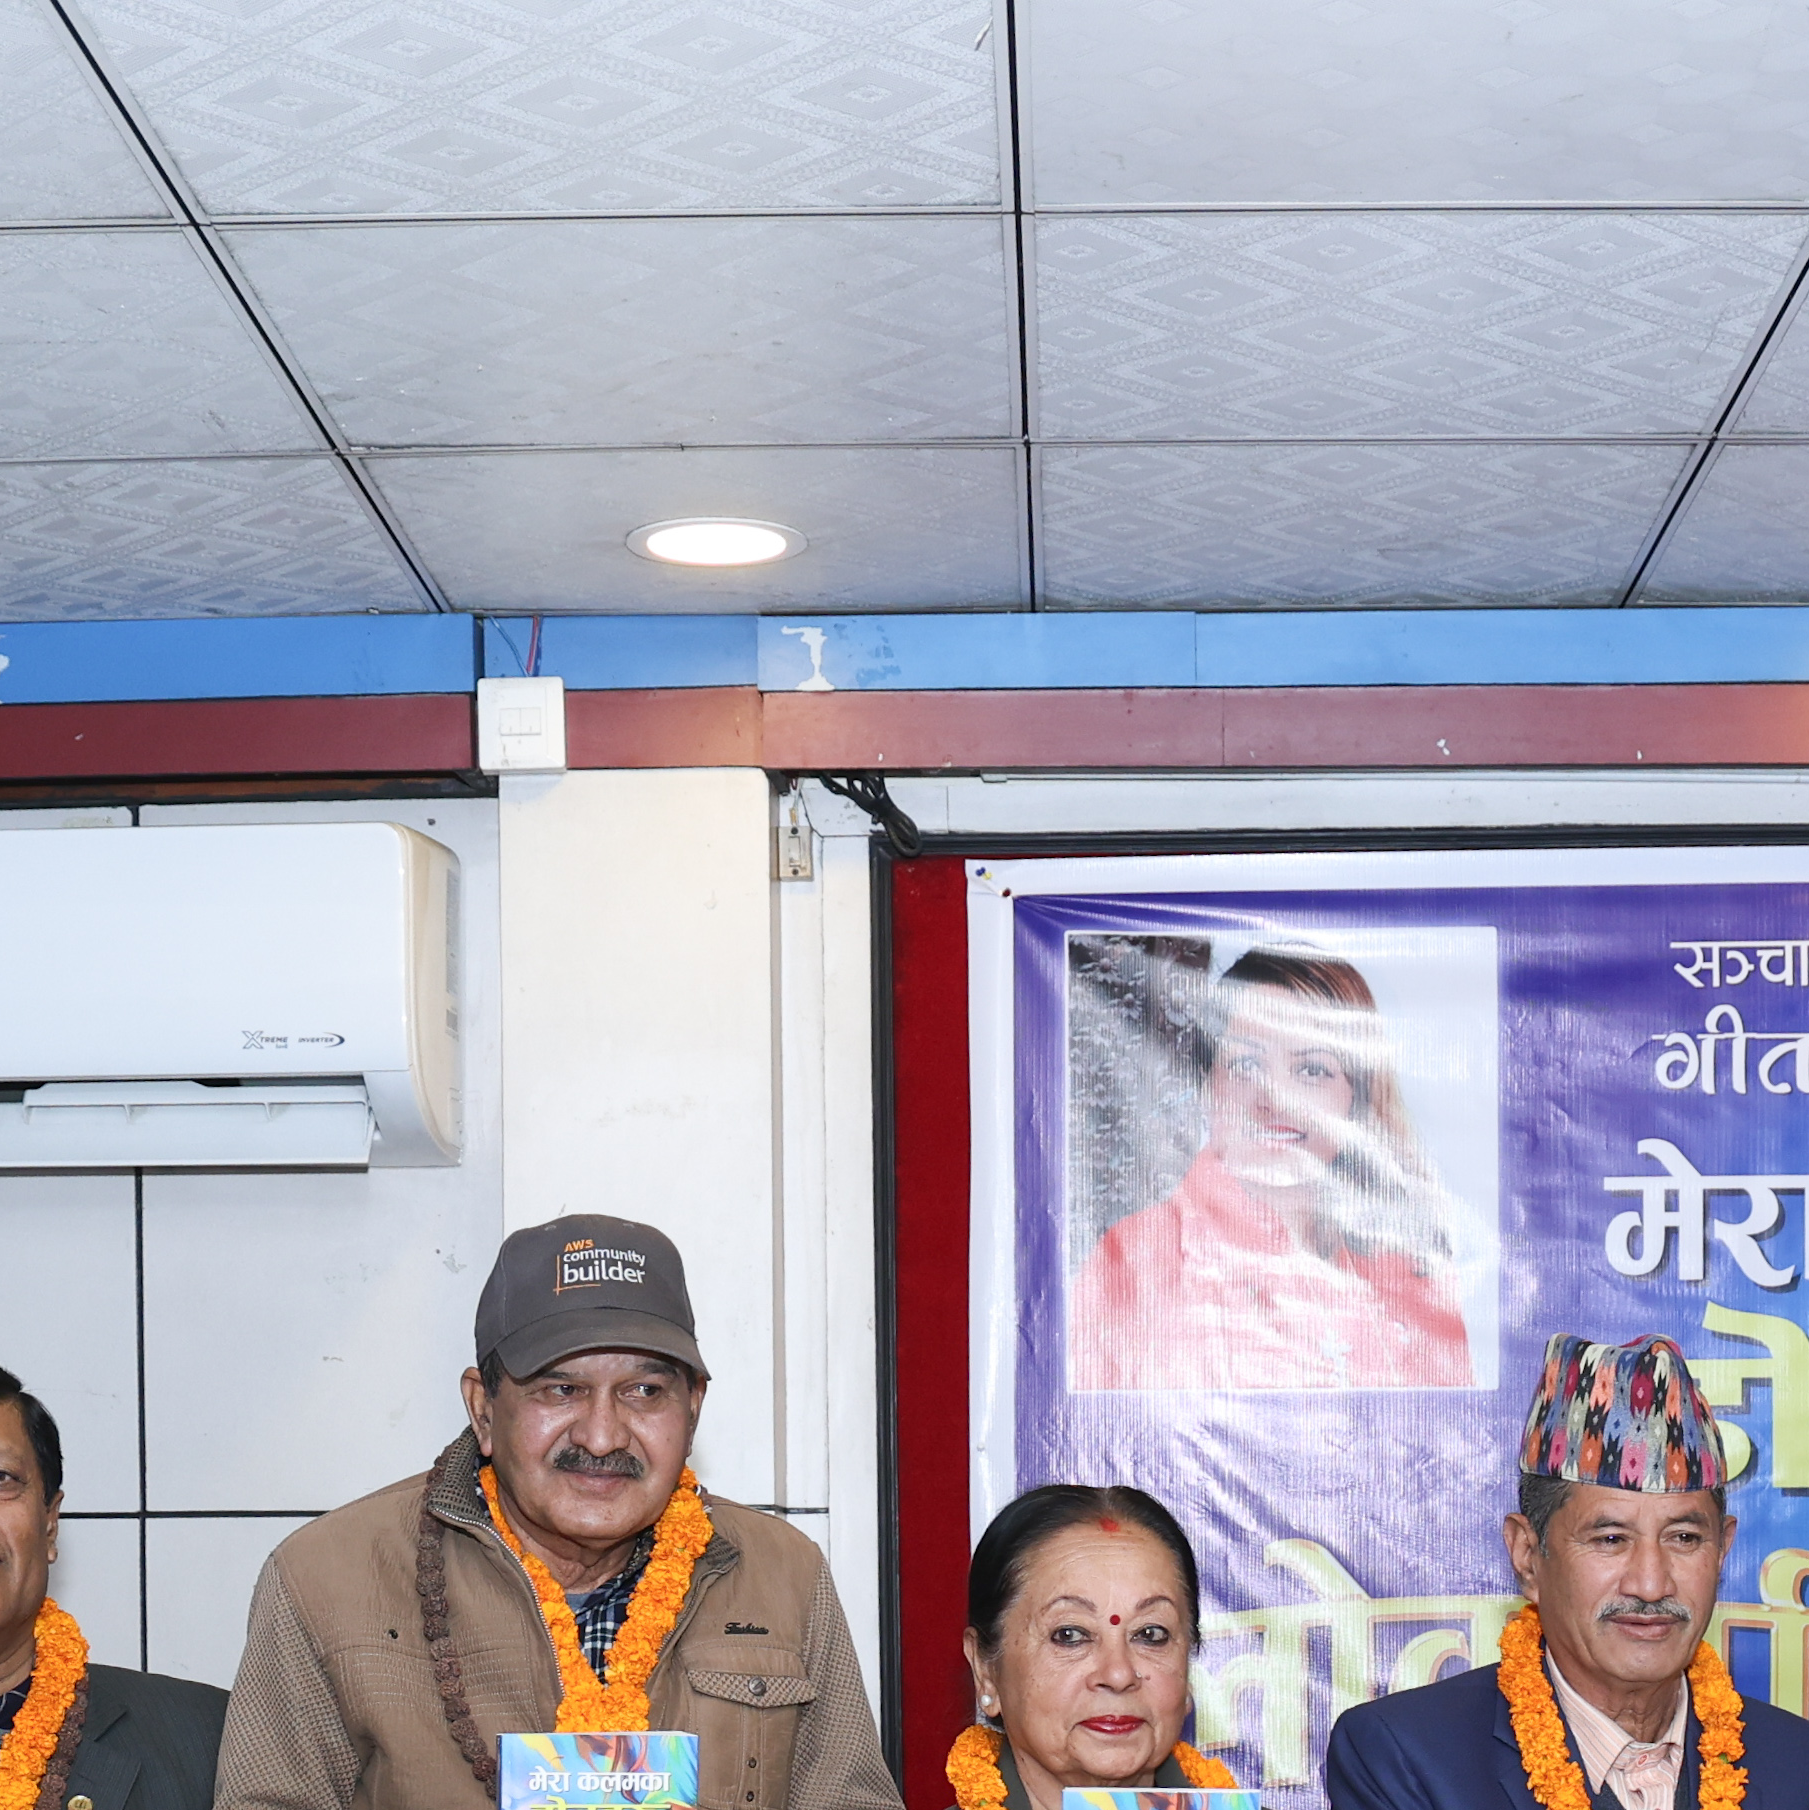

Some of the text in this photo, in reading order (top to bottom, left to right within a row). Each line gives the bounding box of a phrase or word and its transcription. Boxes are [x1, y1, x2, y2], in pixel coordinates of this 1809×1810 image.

[564, 1239, 594, 1252] AWS
[563, 1249, 646, 1267] community
[563, 1261, 646, 1284] builder
[529, 1766, 671, 1793] मेरा कलमका
